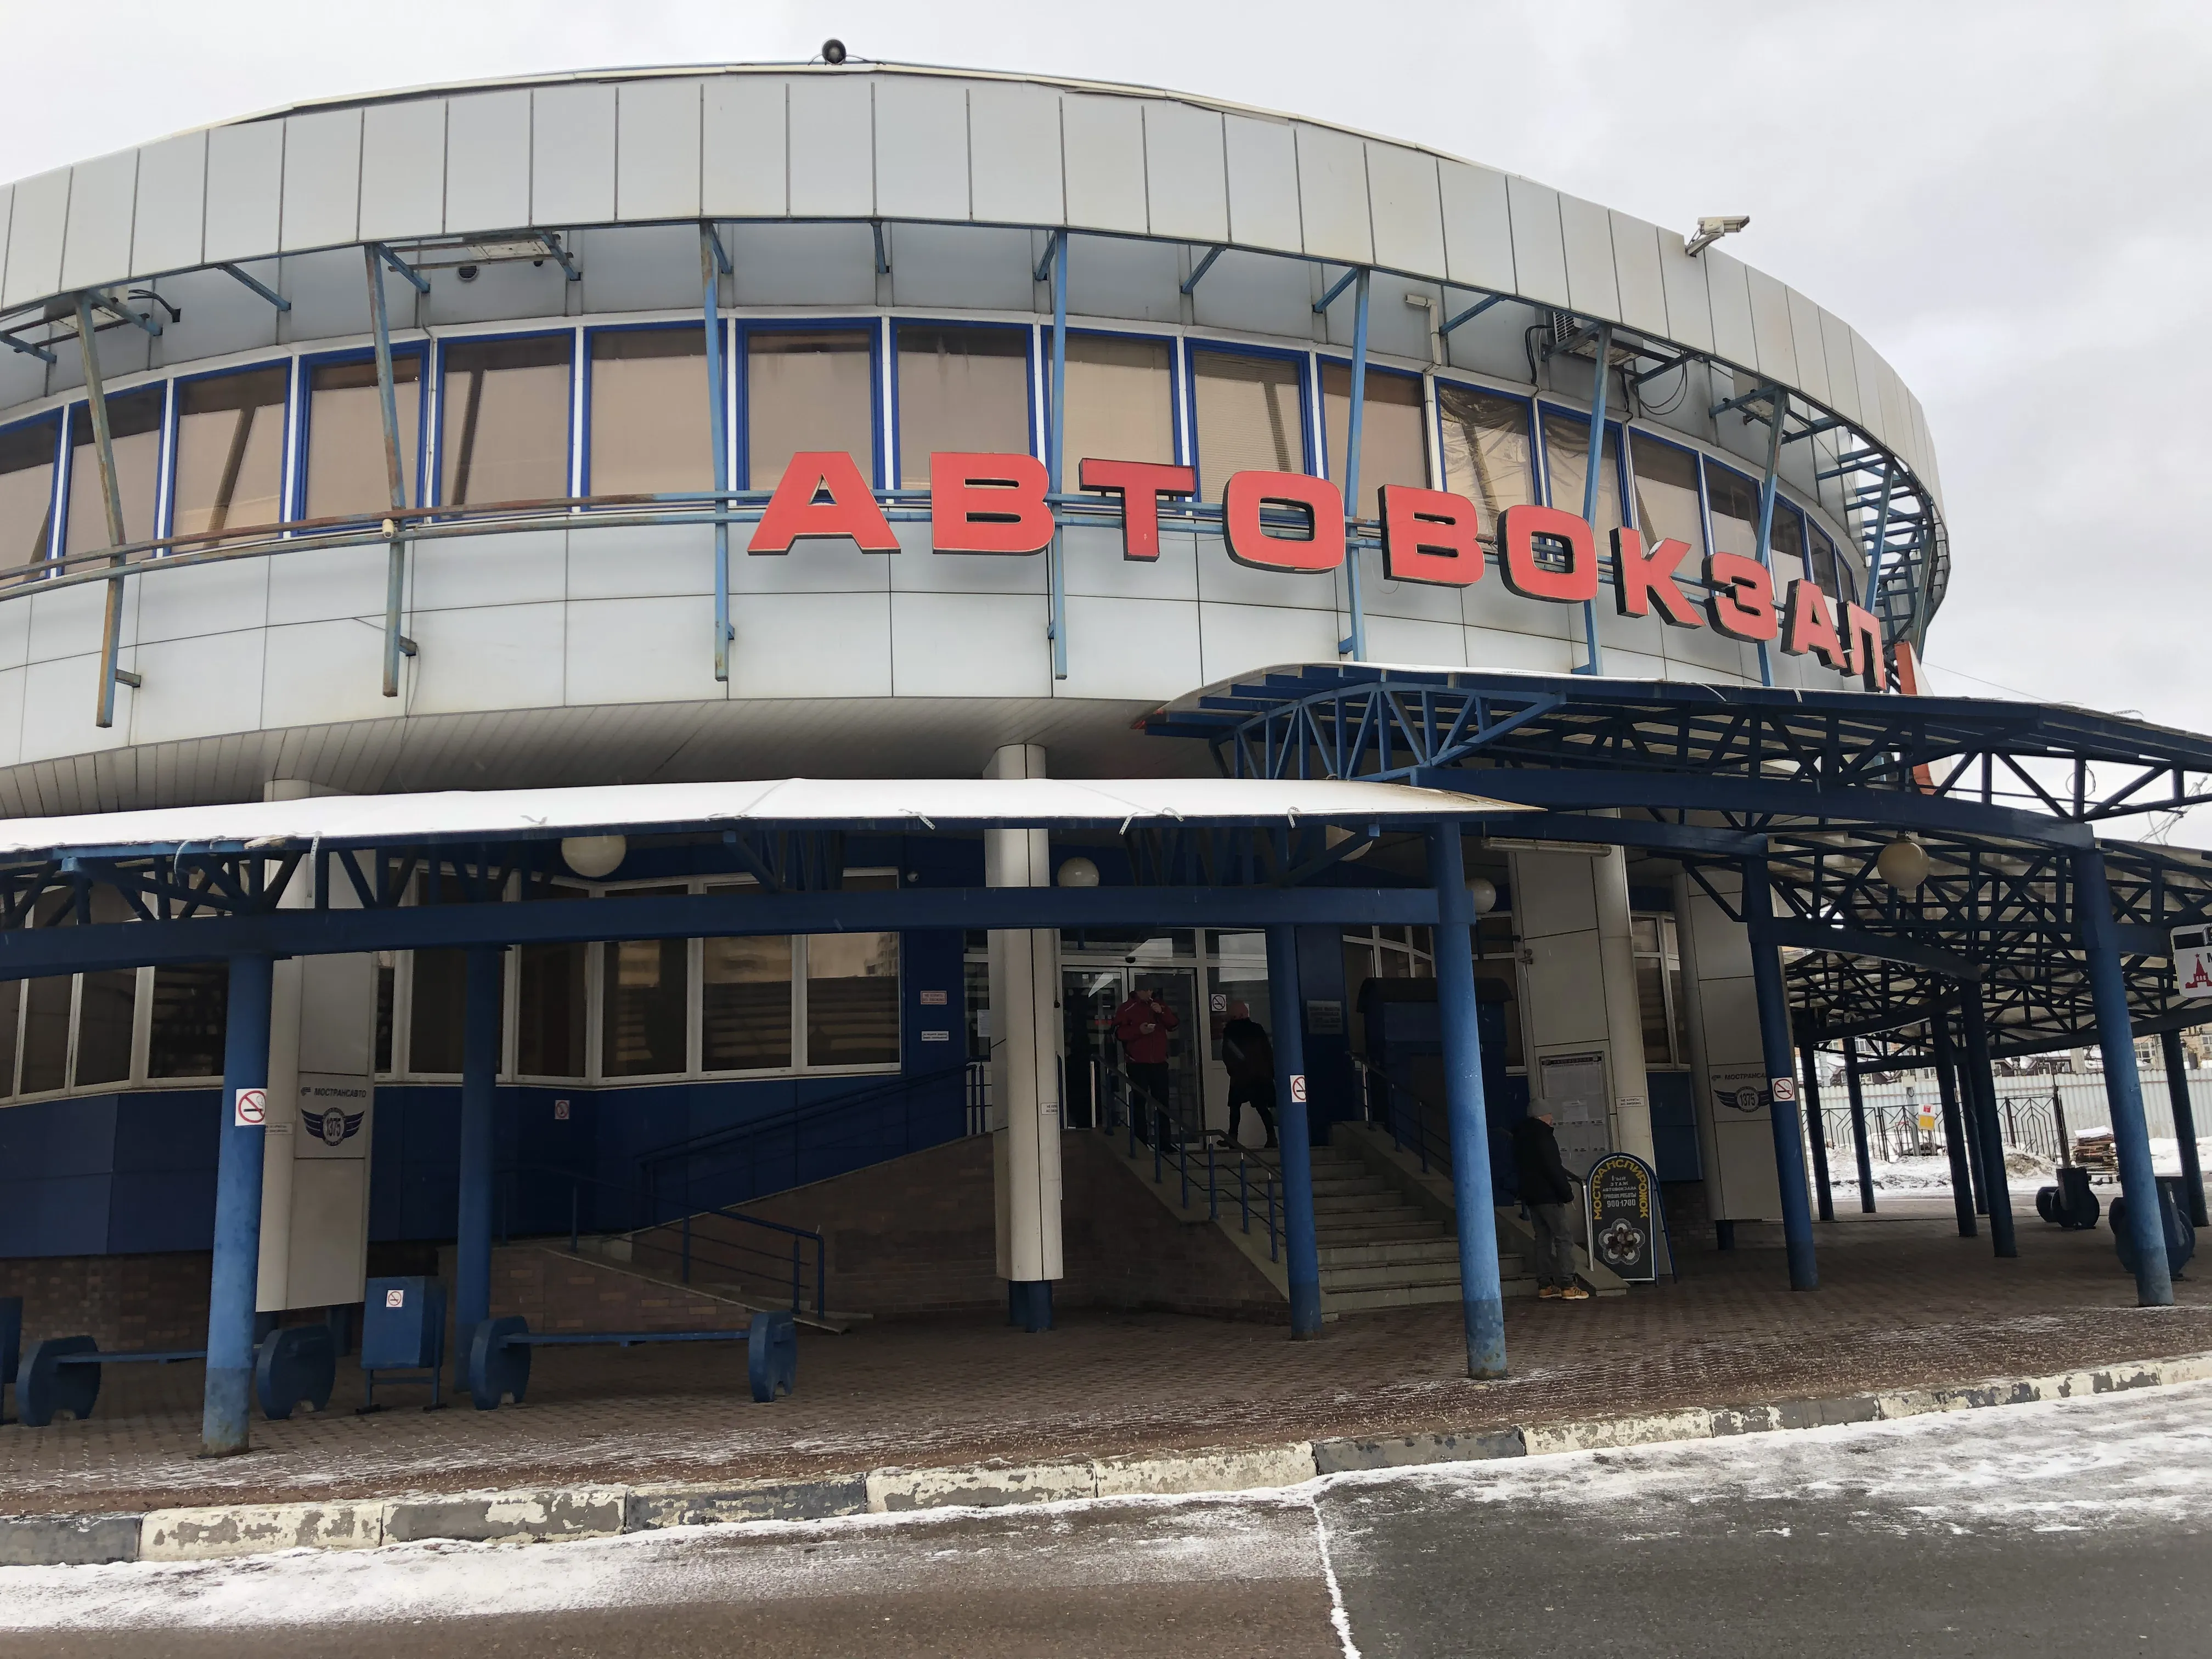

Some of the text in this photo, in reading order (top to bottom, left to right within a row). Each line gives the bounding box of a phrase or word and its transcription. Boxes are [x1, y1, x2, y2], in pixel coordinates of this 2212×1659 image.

[748, 451, 1887, 692] АВТОВОКЗАЛ
[314, 1088, 366, 1098] МОСТРАНСАВТО
[1740, 1093, 1756, 1107] 1375
[326, 1118, 341, 1137] 1375
[1593, 1159, 1648, 1220] МОСТРАНСПИРОЖОК
